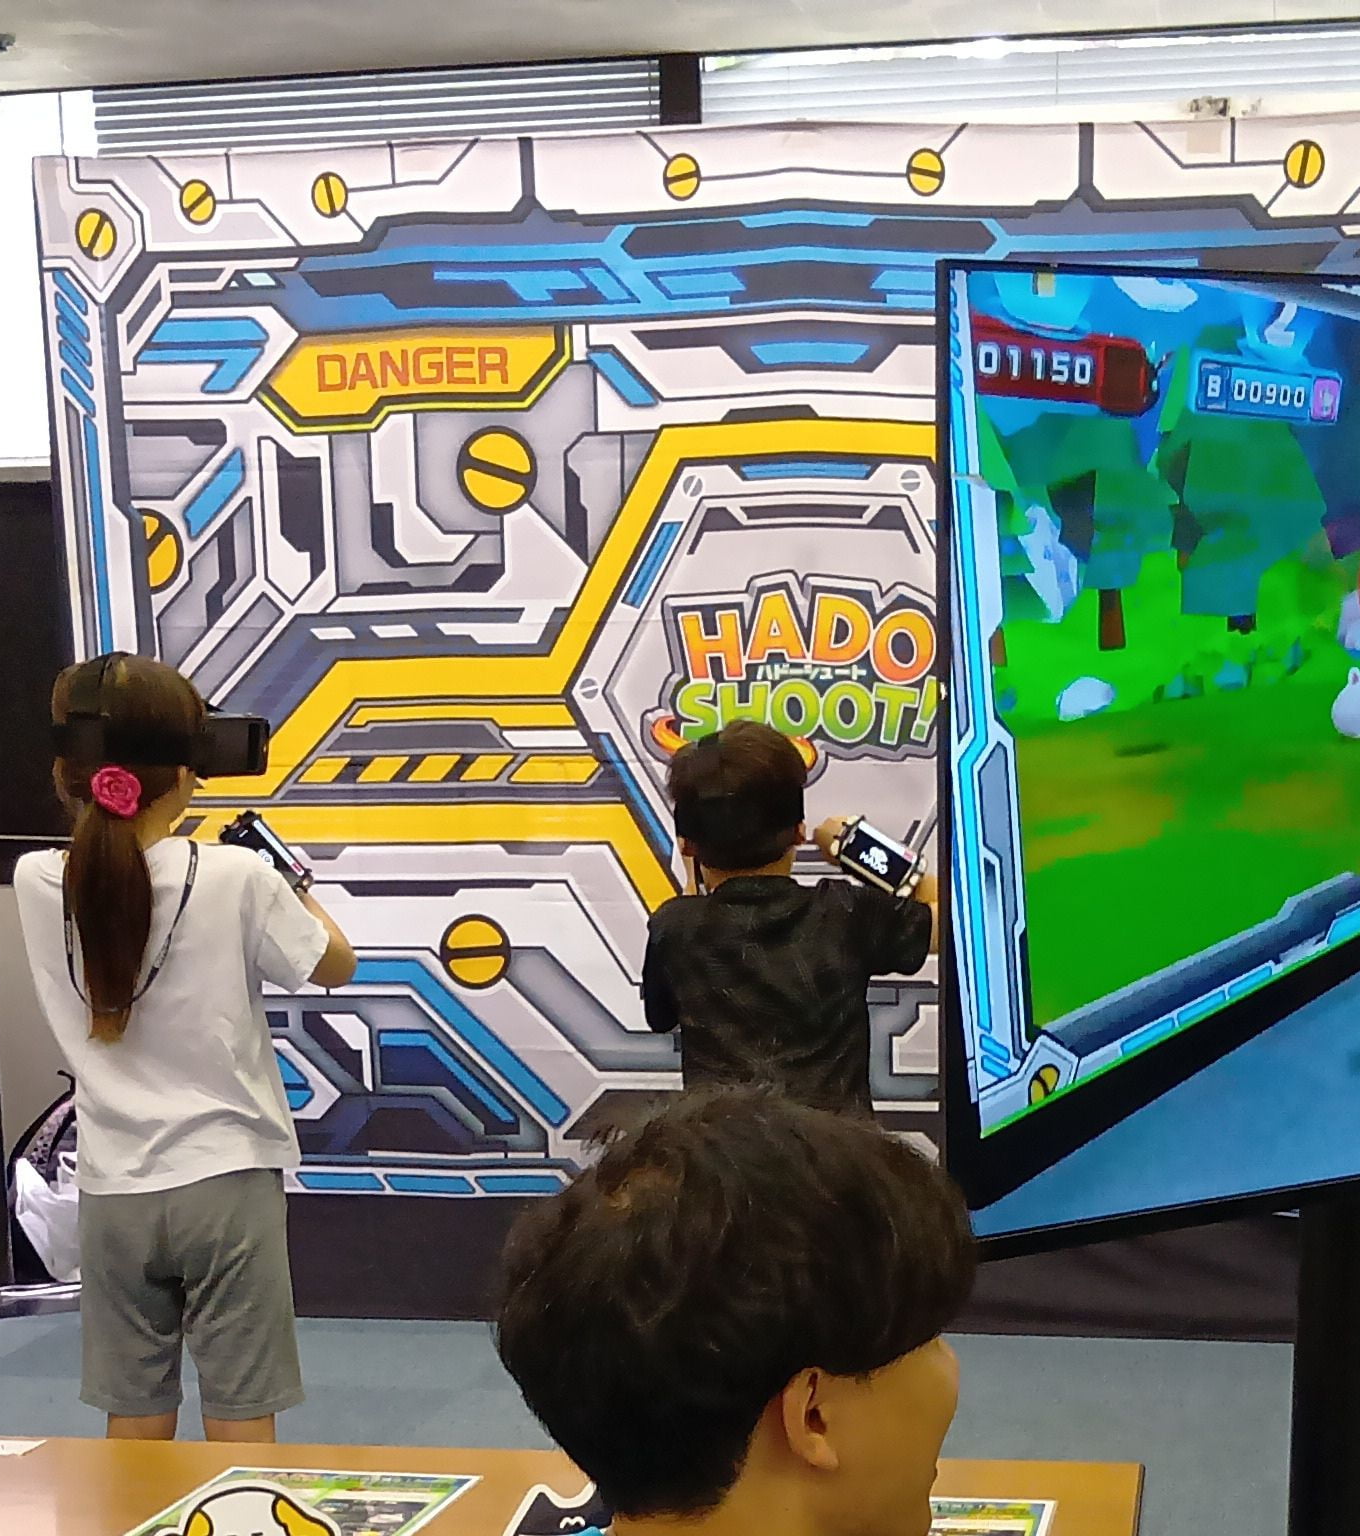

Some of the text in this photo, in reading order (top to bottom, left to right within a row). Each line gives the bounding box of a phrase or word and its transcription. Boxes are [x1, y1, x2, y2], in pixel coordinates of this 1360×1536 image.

[317, 346, 509, 393] DANGER
[976, 341, 1093, 386] 01150
[1233, 379, 1305, 408] 00900
[679, 590, 937, 684] HADO
[677, 676, 937, 745] SHOOT!
